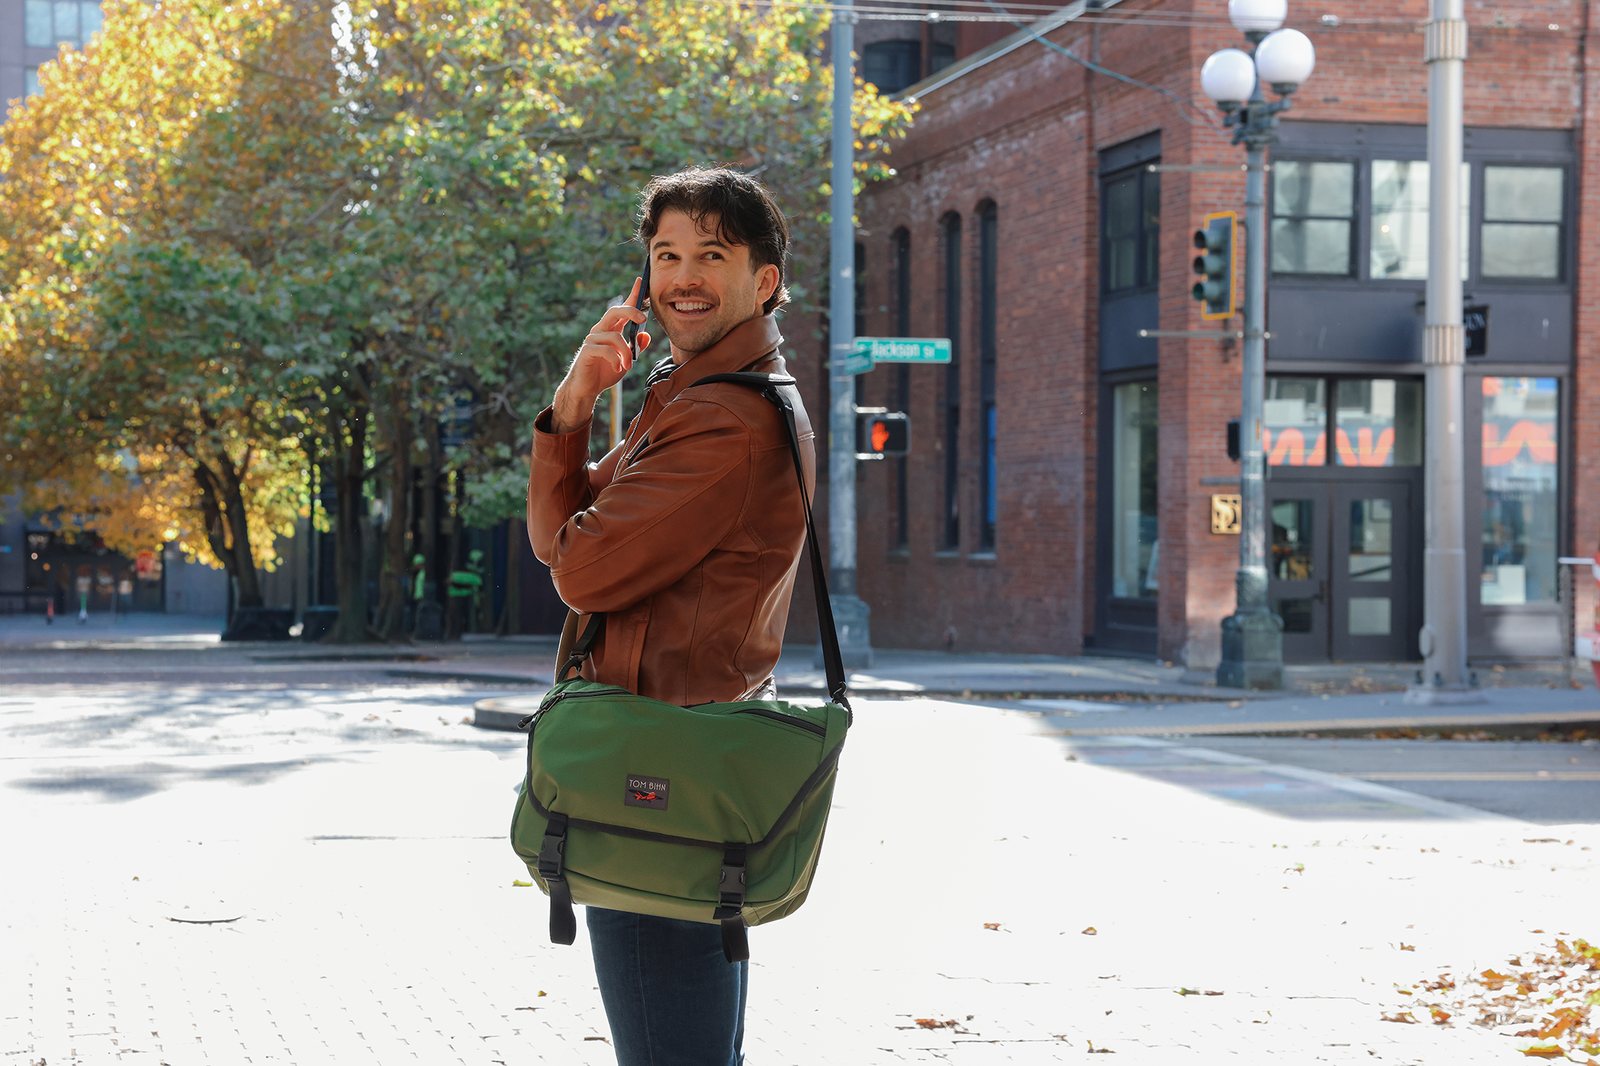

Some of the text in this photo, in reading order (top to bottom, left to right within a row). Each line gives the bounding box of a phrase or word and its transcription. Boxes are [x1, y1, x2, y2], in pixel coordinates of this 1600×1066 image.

[870, 340, 921, 358] Jackson
[628, 779, 667, 791] TOM BIHN
